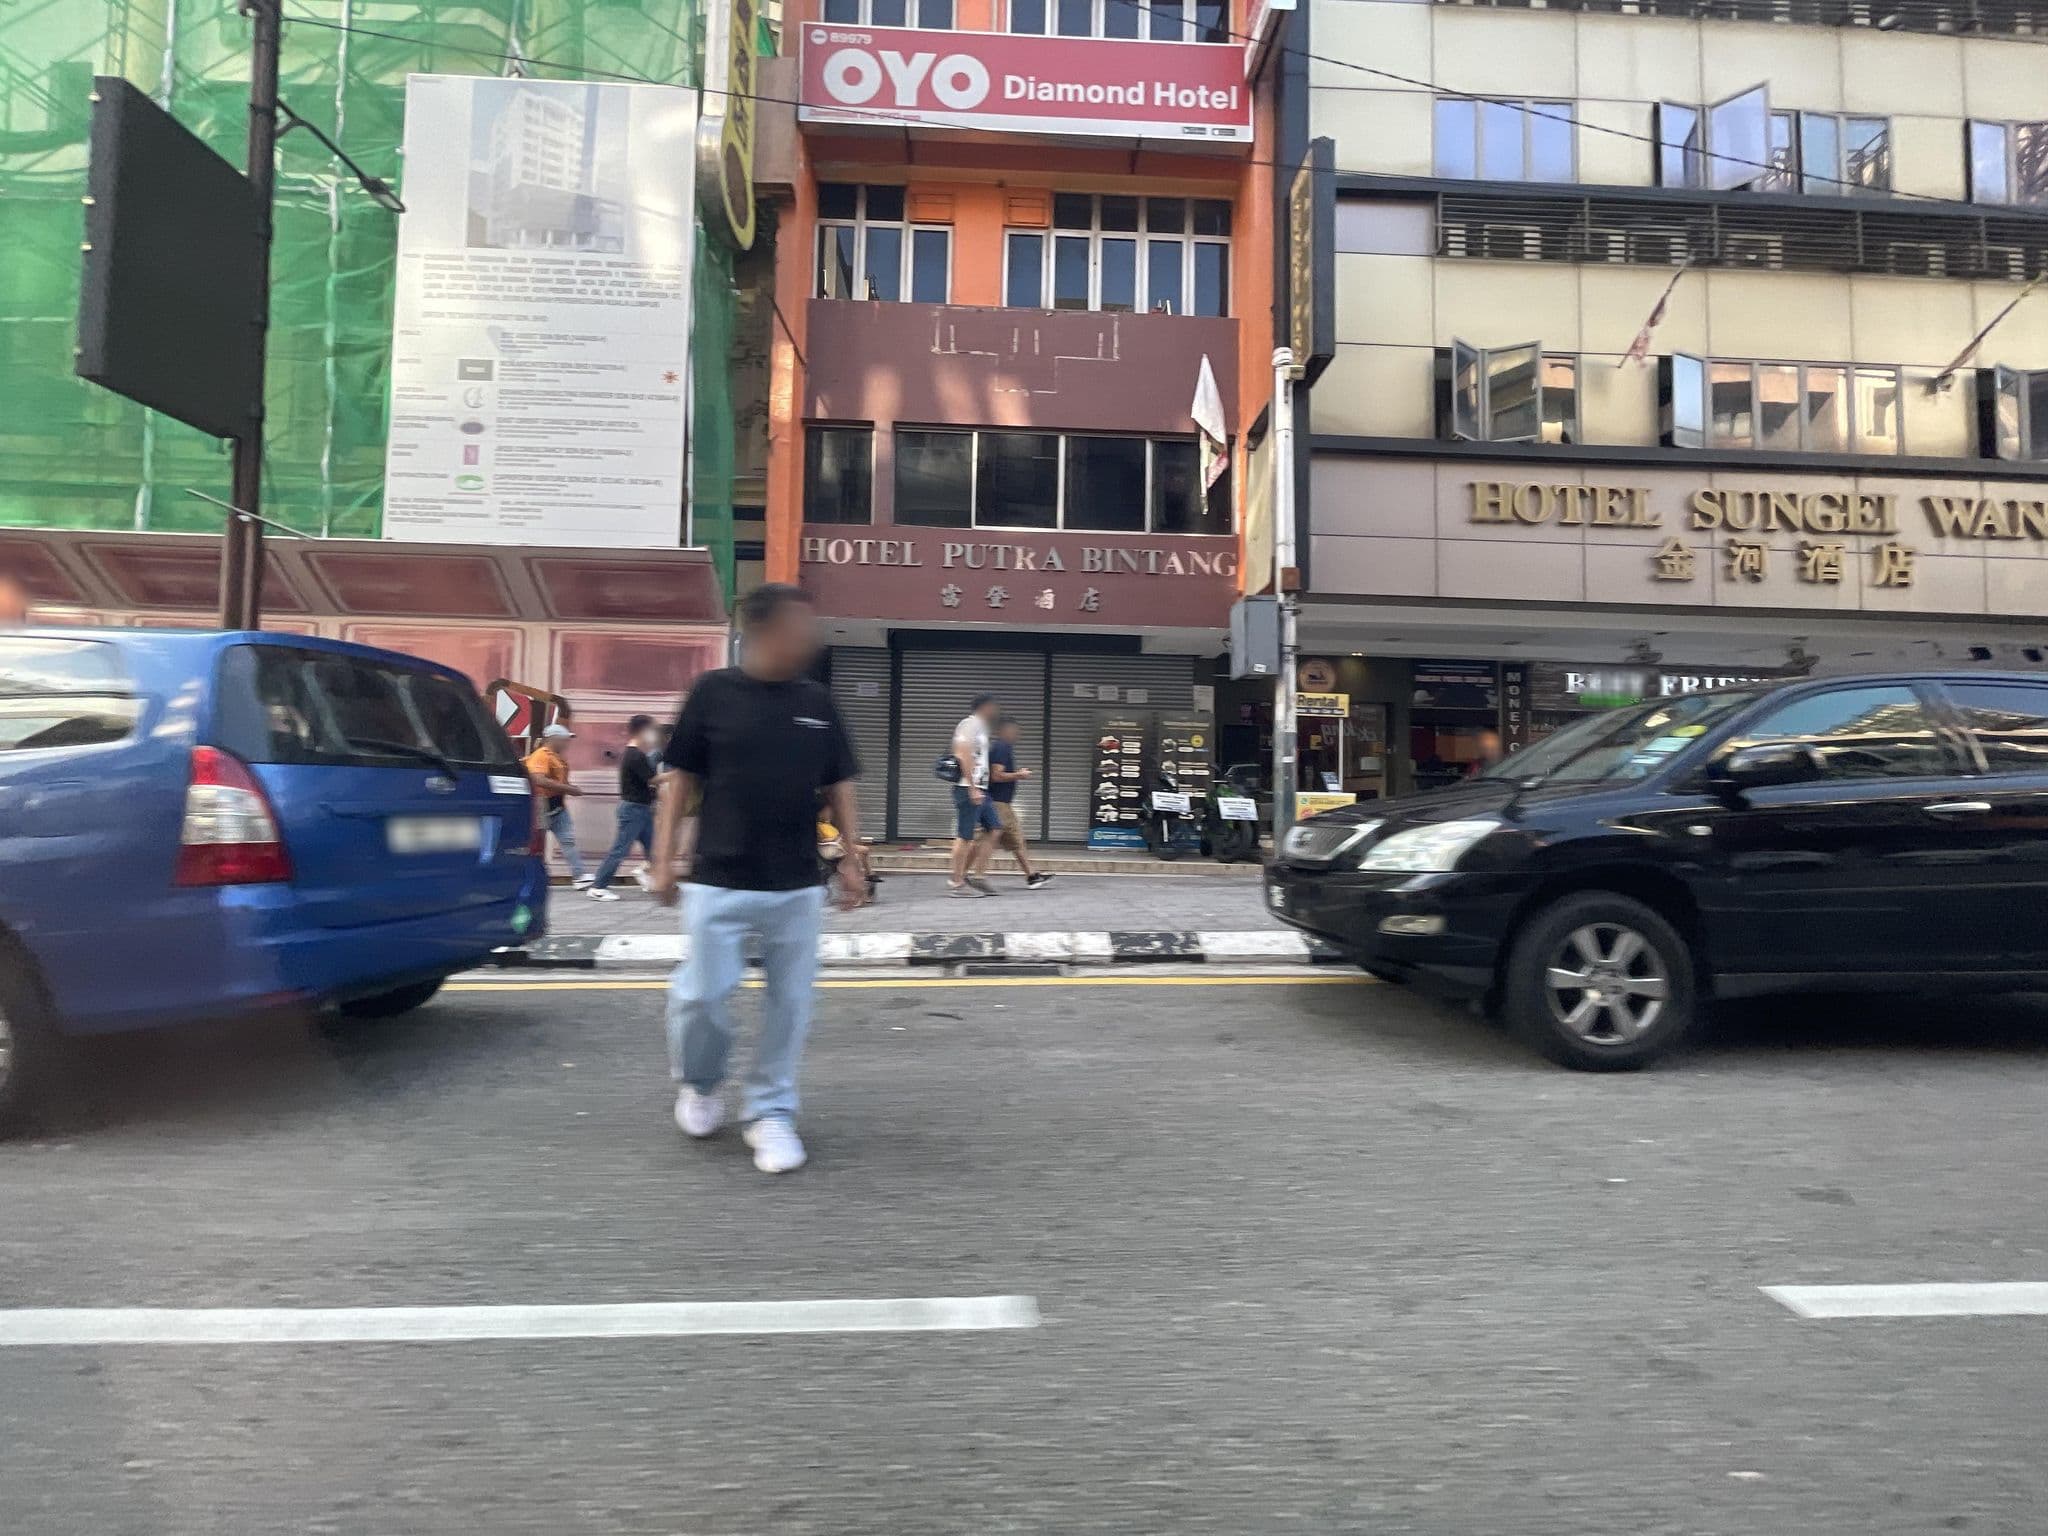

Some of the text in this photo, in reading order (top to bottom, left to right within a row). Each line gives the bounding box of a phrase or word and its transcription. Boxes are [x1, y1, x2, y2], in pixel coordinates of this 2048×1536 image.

[823, 48, 990, 110] OYO
[1003, 74, 1239, 110] Diamond Hotel
[1470, 481, 1664, 527] HOTEL
[1690, 487, 1900, 535] SUNGEI
[801, 537, 1237, 577] HOTEL PUTRA BINTANG
[1650, 536, 1916, 587] 金河酒店
[1297, 694, 1339, 708] Rental
